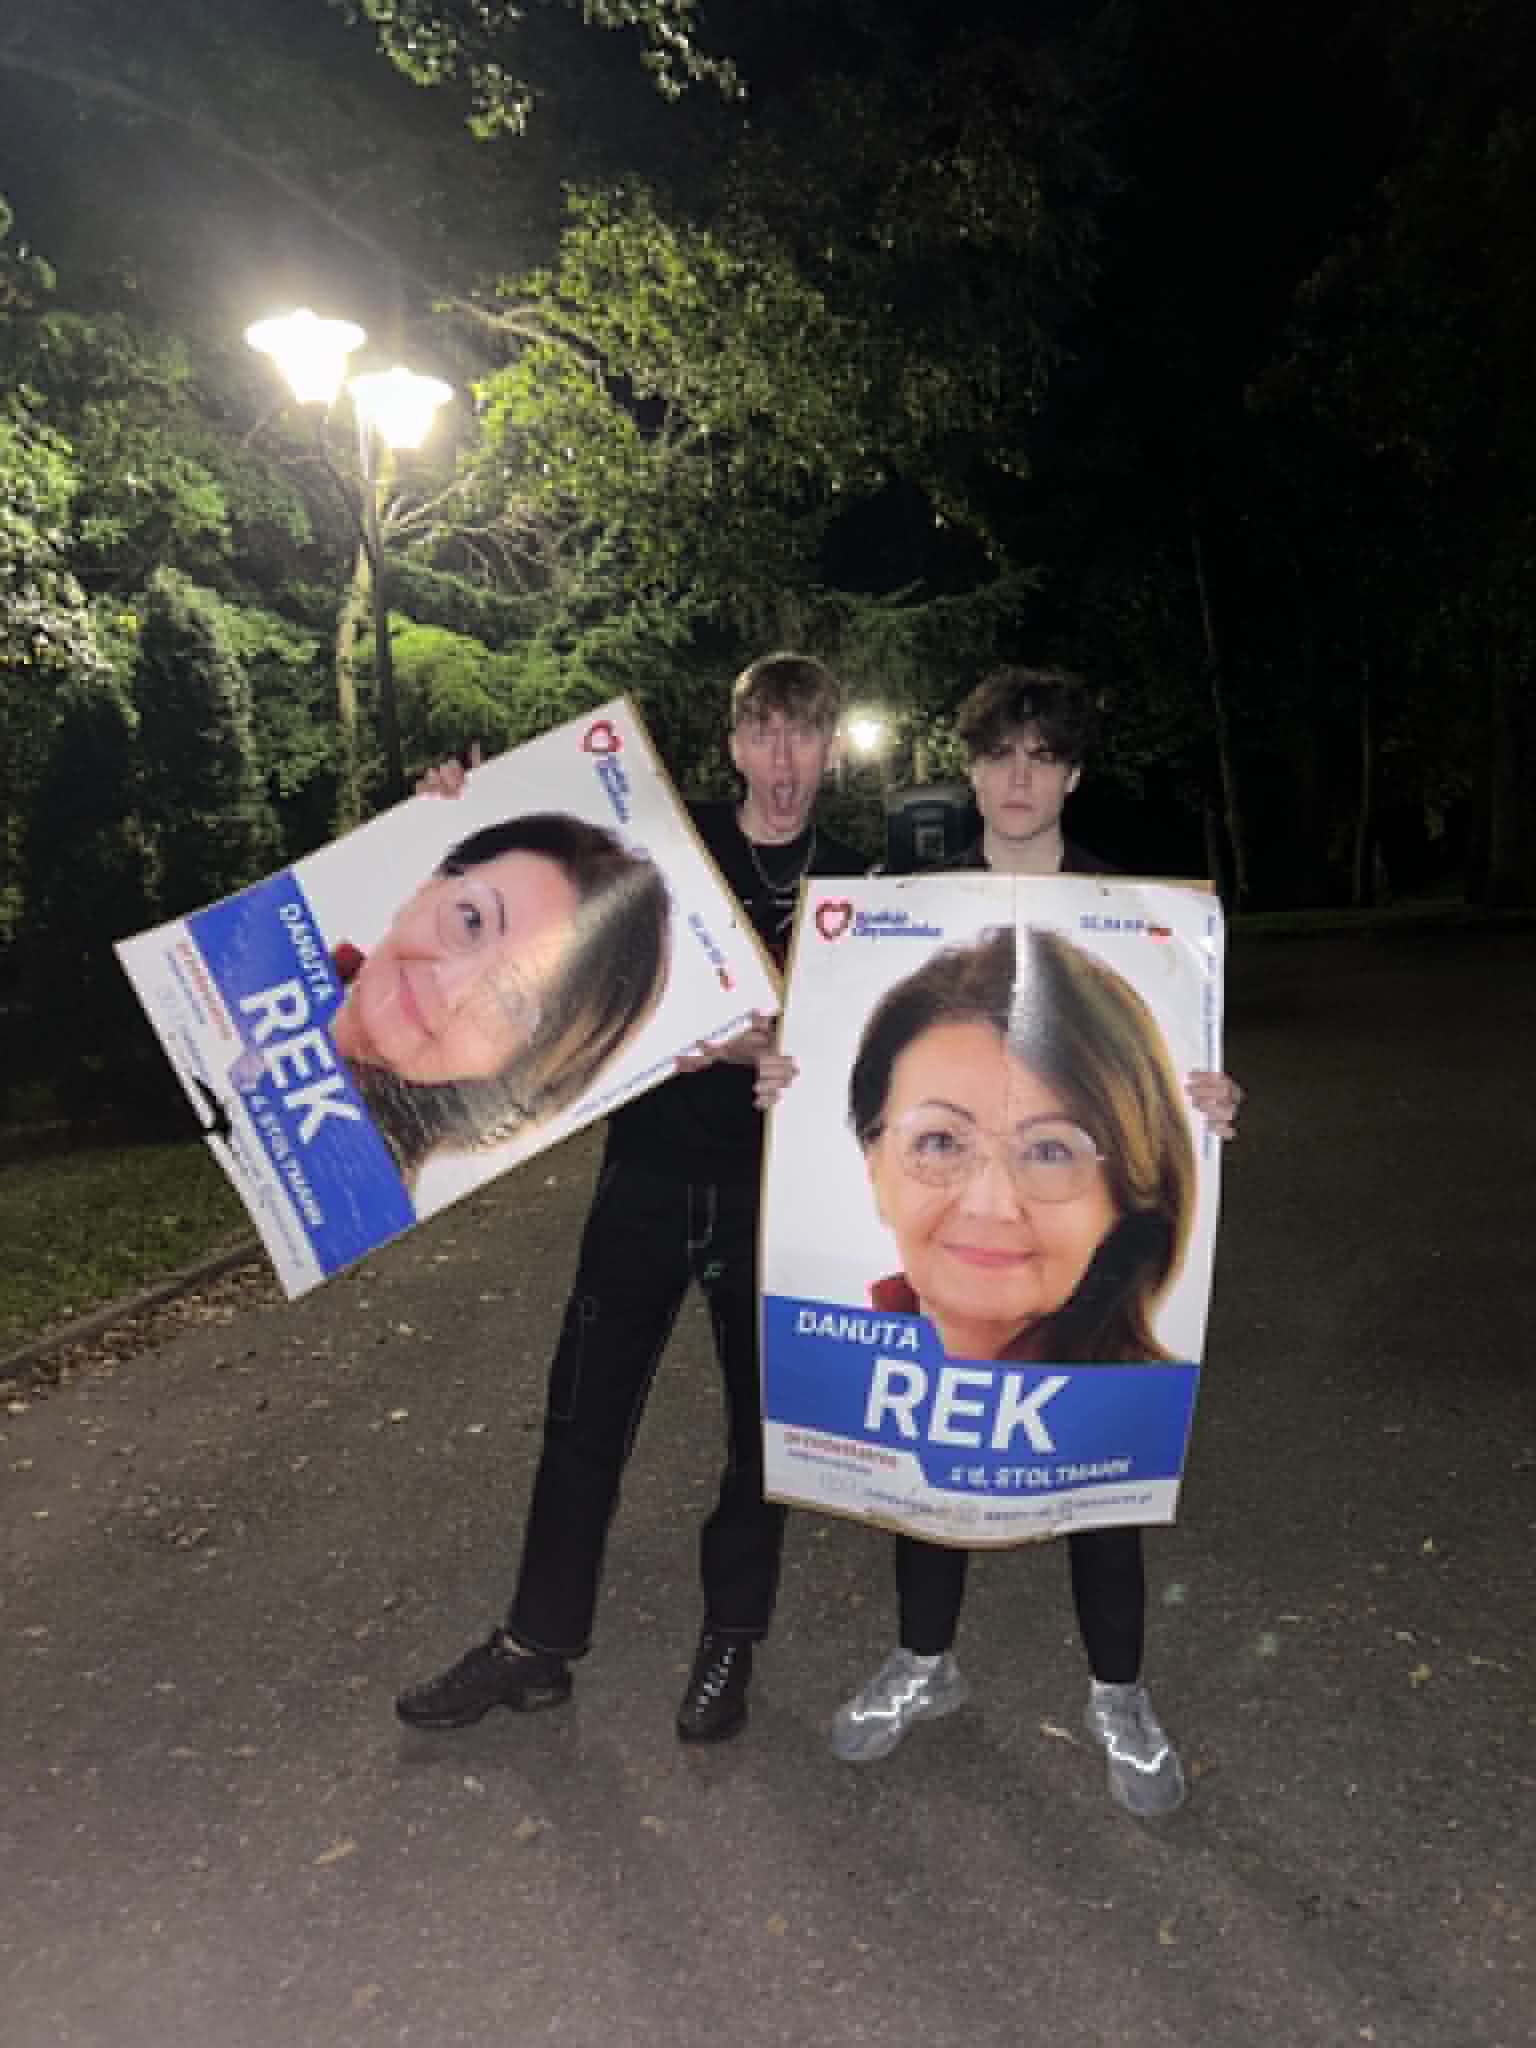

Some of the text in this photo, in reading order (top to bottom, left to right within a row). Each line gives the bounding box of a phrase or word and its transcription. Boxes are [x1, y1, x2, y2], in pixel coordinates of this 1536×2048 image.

[280, 903, 334, 1000] DANUTA
[239, 979, 362, 1144] REK
[797, 1311, 920, 1353] DANUTA
[864, 1358, 1073, 1455] REK
